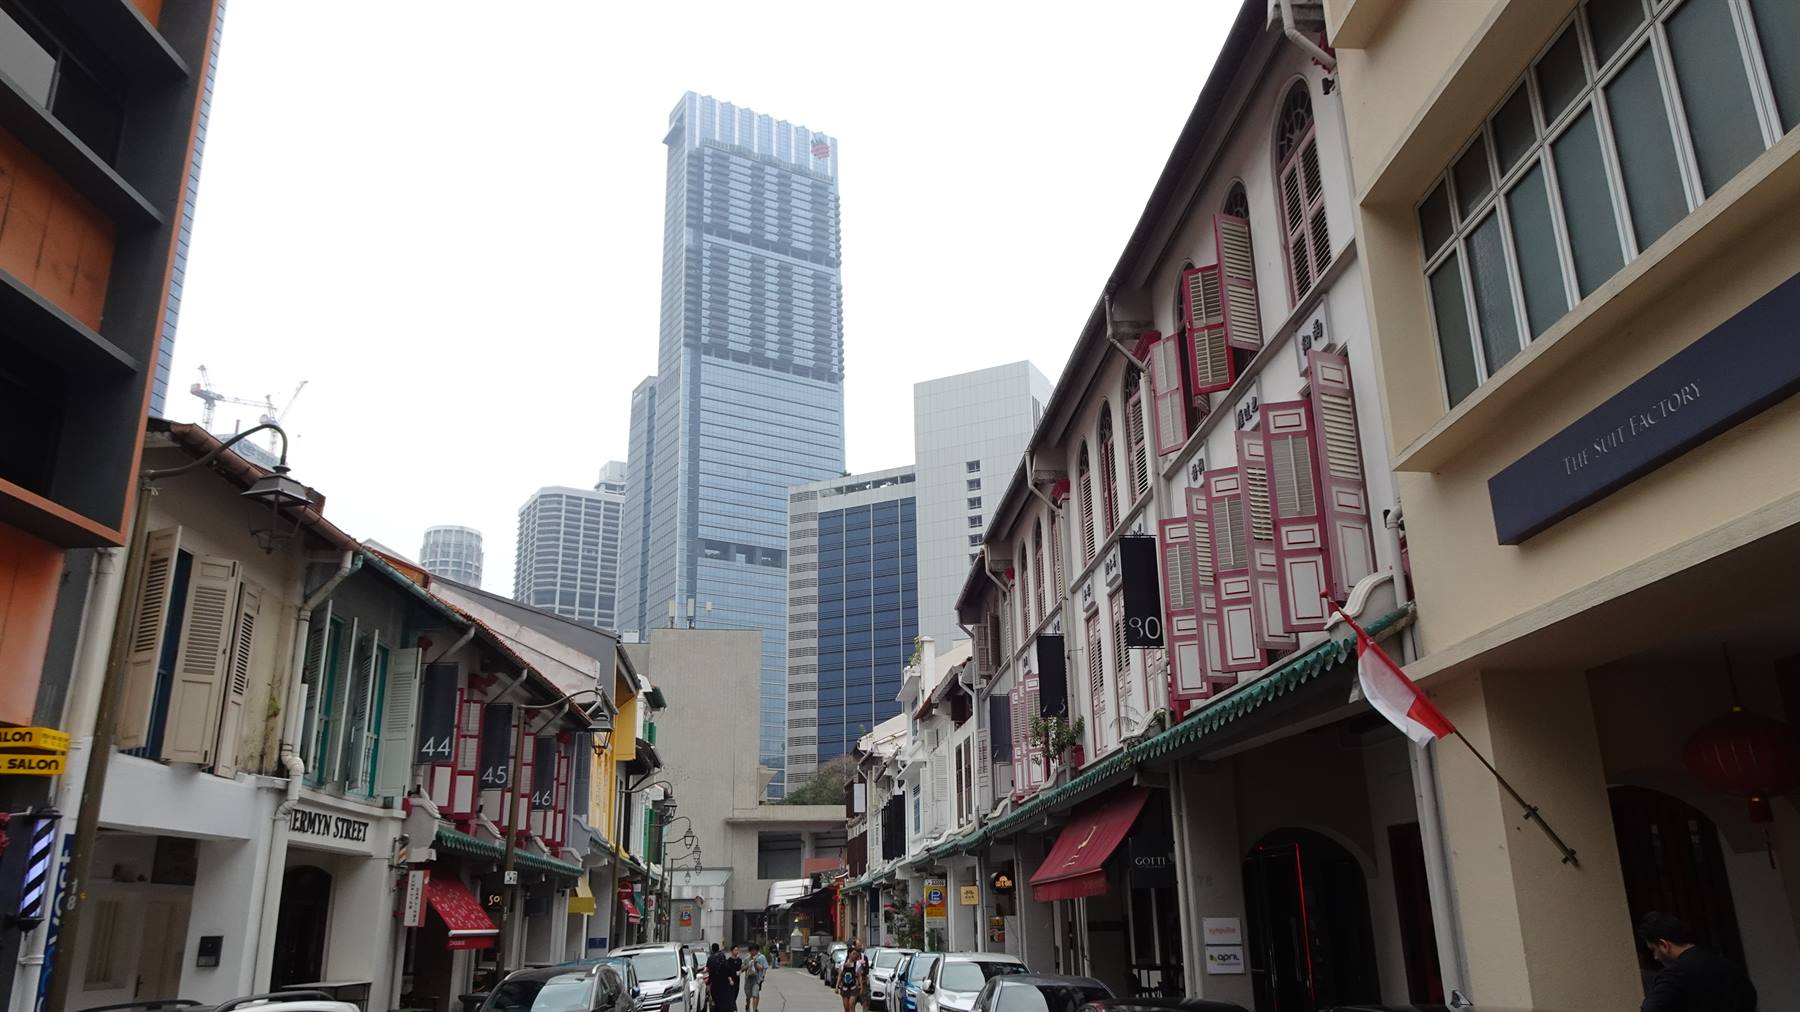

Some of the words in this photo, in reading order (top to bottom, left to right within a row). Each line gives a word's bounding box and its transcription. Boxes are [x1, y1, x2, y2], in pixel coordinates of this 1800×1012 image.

[1562, 446, 1588, 475] THE
[1593, 425, 1625, 459] SUIT
[1629, 381, 1701, 436] FACTORY
[420, 736, 452, 757] 44
[7, 758, 59, 770] SALON
[481, 765, 507, 784] 45
[531, 789, 552, 806] 46
[332, 816, 369, 842] STREET
[1134, 856, 1166, 866] GOTTI
